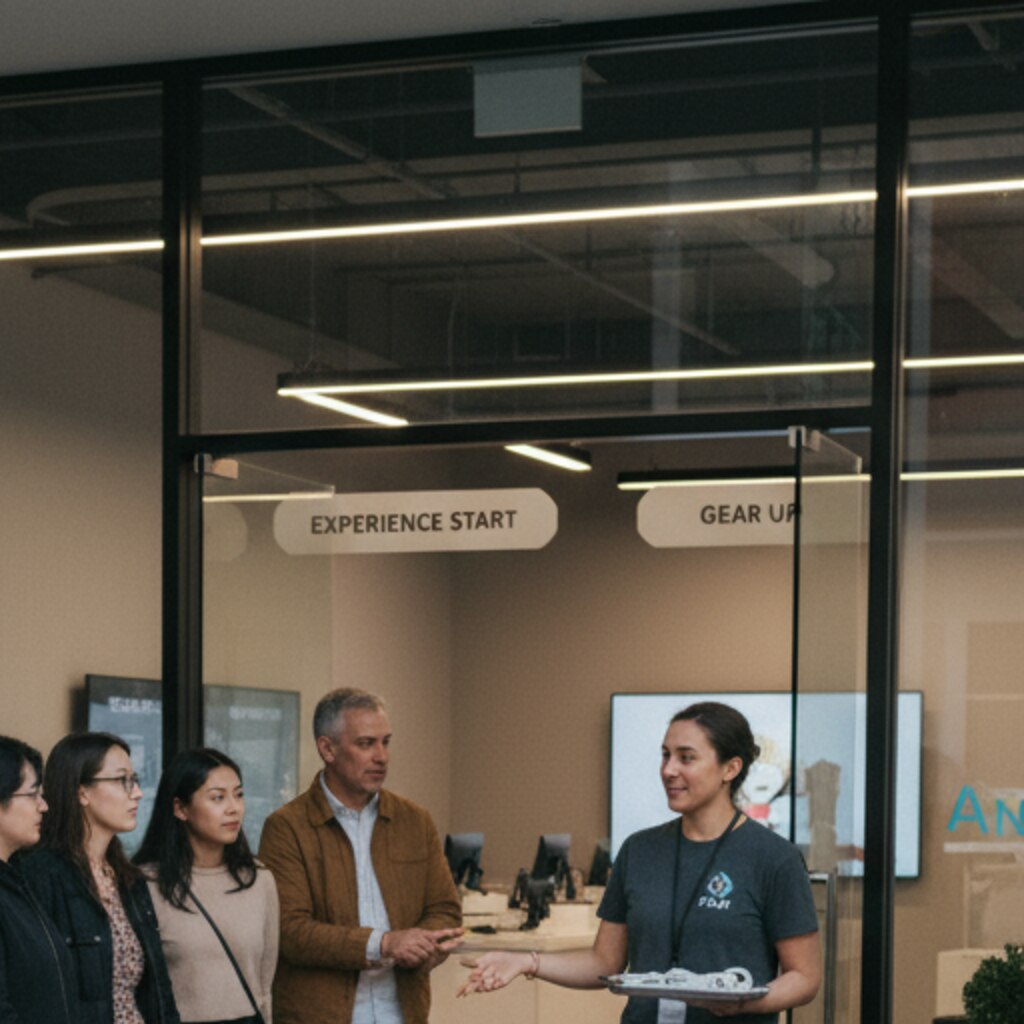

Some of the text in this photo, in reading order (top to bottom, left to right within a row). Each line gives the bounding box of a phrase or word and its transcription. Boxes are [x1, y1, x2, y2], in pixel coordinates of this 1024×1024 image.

[310, 509, 517, 535] EXPERIENCE START
[699, 504, 761, 525] GEAR
